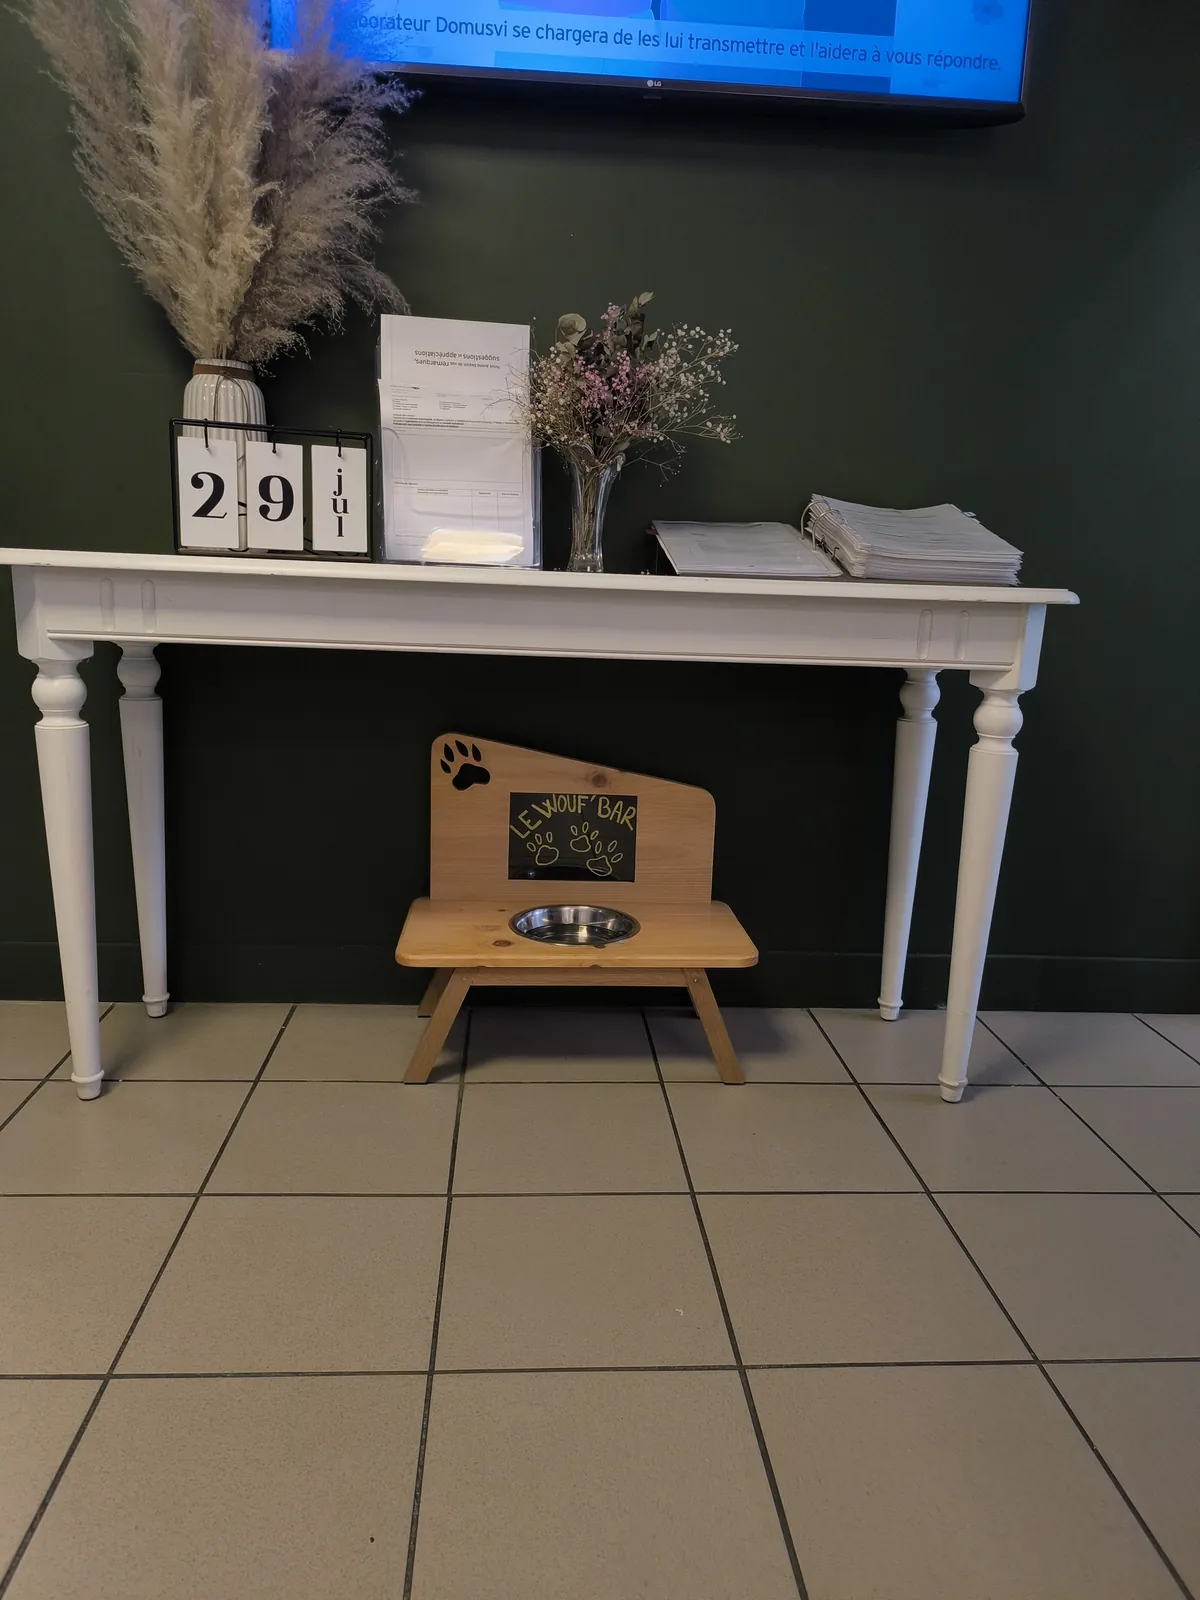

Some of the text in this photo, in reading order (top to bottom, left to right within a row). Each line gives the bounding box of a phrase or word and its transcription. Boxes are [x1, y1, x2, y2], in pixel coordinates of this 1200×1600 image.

[436, 17, 508, 38] Domusvi
[512, 25, 531, 39] se
[536, 23, 608, 46] chargera
[613, 28, 633, 46] de
[637, 31, 660, 49] les
[664, 31, 683, 50] lui
[687, 33, 785, 57] transmettre
[789, 41, 805, 58] et
[810, 44, 868, 62] l'aidera
[871, 45, 881, 63] à
[886, 51, 922, 66] vous
[927, 50, 1002, 72] répondre.
[414, 350, 457, 359] appréciations
[414, 358, 449, 367] remarques,
[462, 354, 500, 362] suggestions
[330, 468, 349, 538] jul
[510, 810, 542, 839] LE
